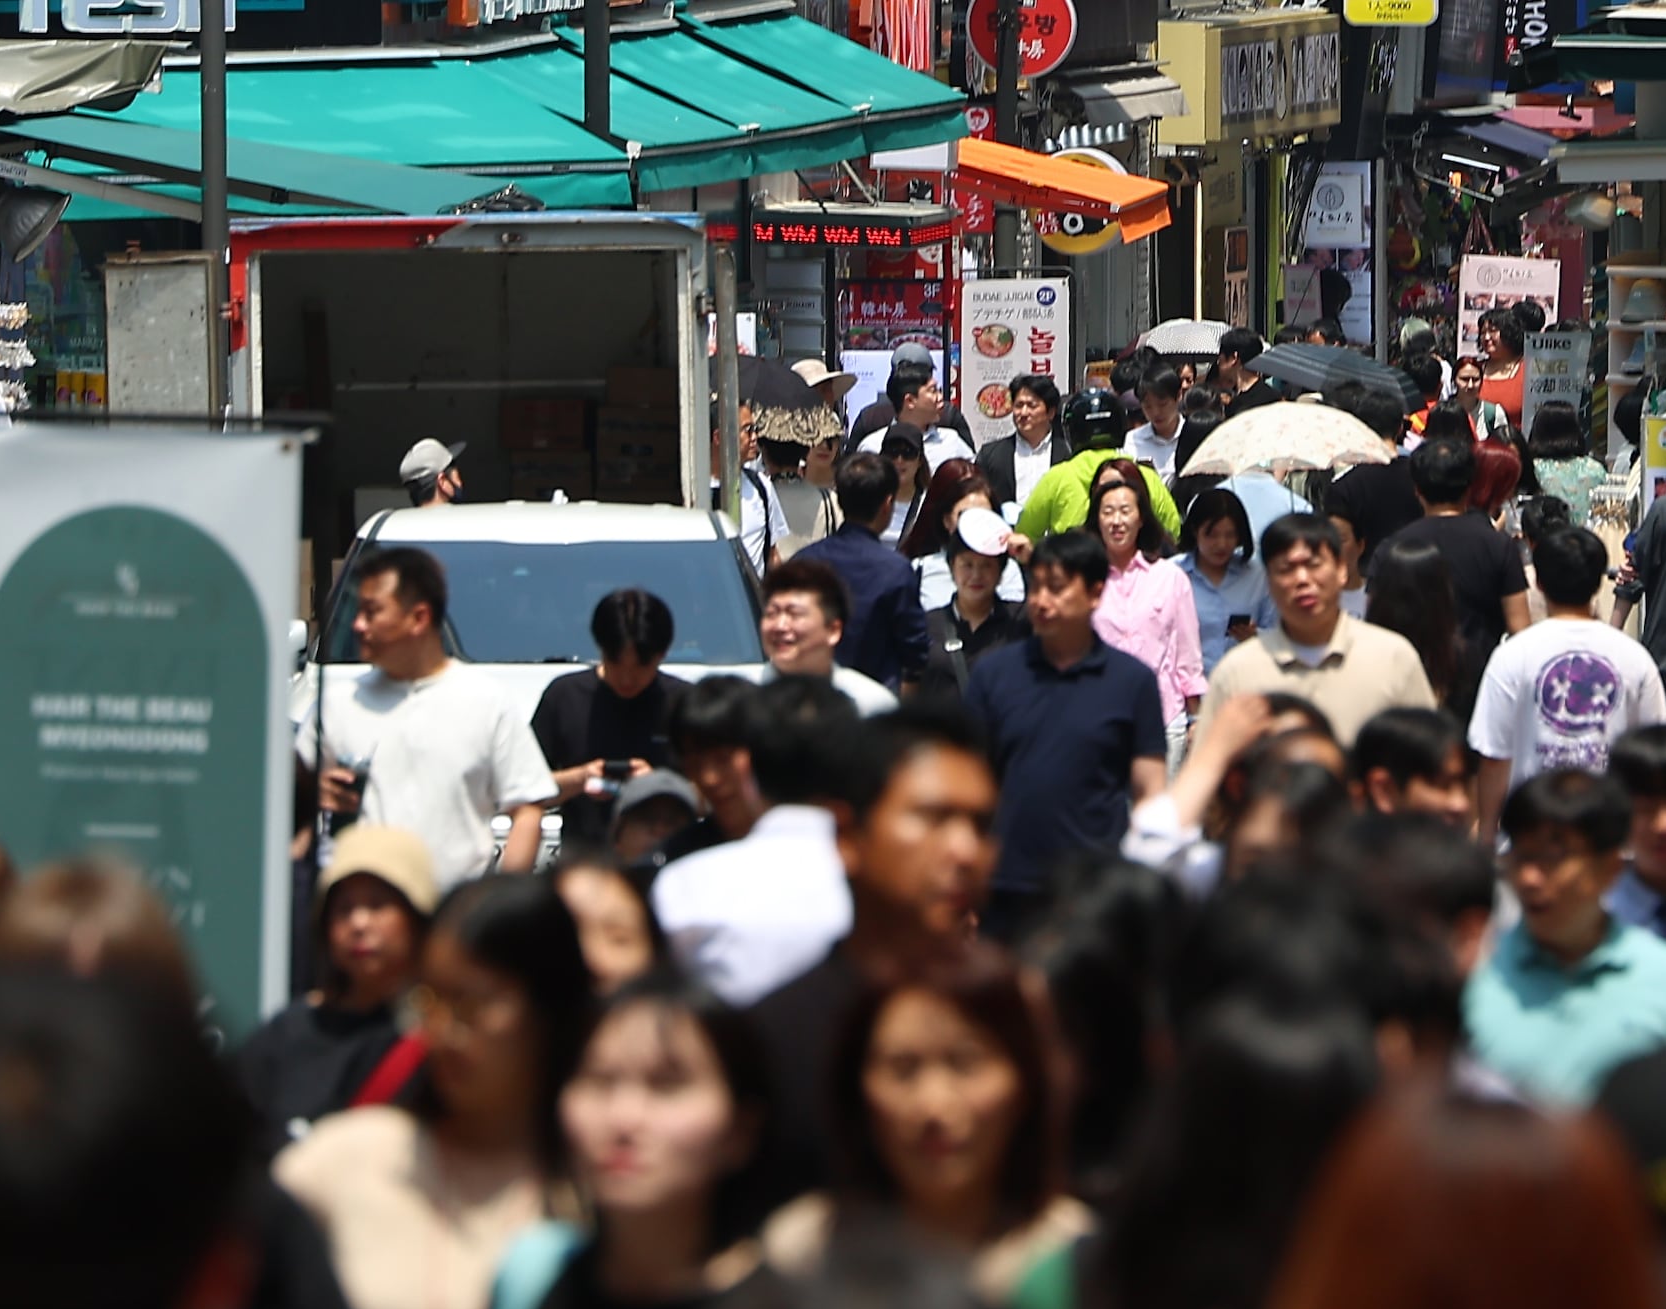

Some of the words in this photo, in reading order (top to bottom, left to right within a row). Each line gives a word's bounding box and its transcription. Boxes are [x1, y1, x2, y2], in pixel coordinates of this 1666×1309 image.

[780, 224, 817, 243] WM
[824, 225, 859, 245] WM
[866, 226, 901, 246] WM
[923, 282, 941, 299] 3F
[1038, 289, 1053, 303] 2F
[1533, 337, 1572, 351] Ulike
[30, 692, 91, 719] HAIR
[95, 694, 139, 720] THE
[144, 696, 211, 723] BEAU
